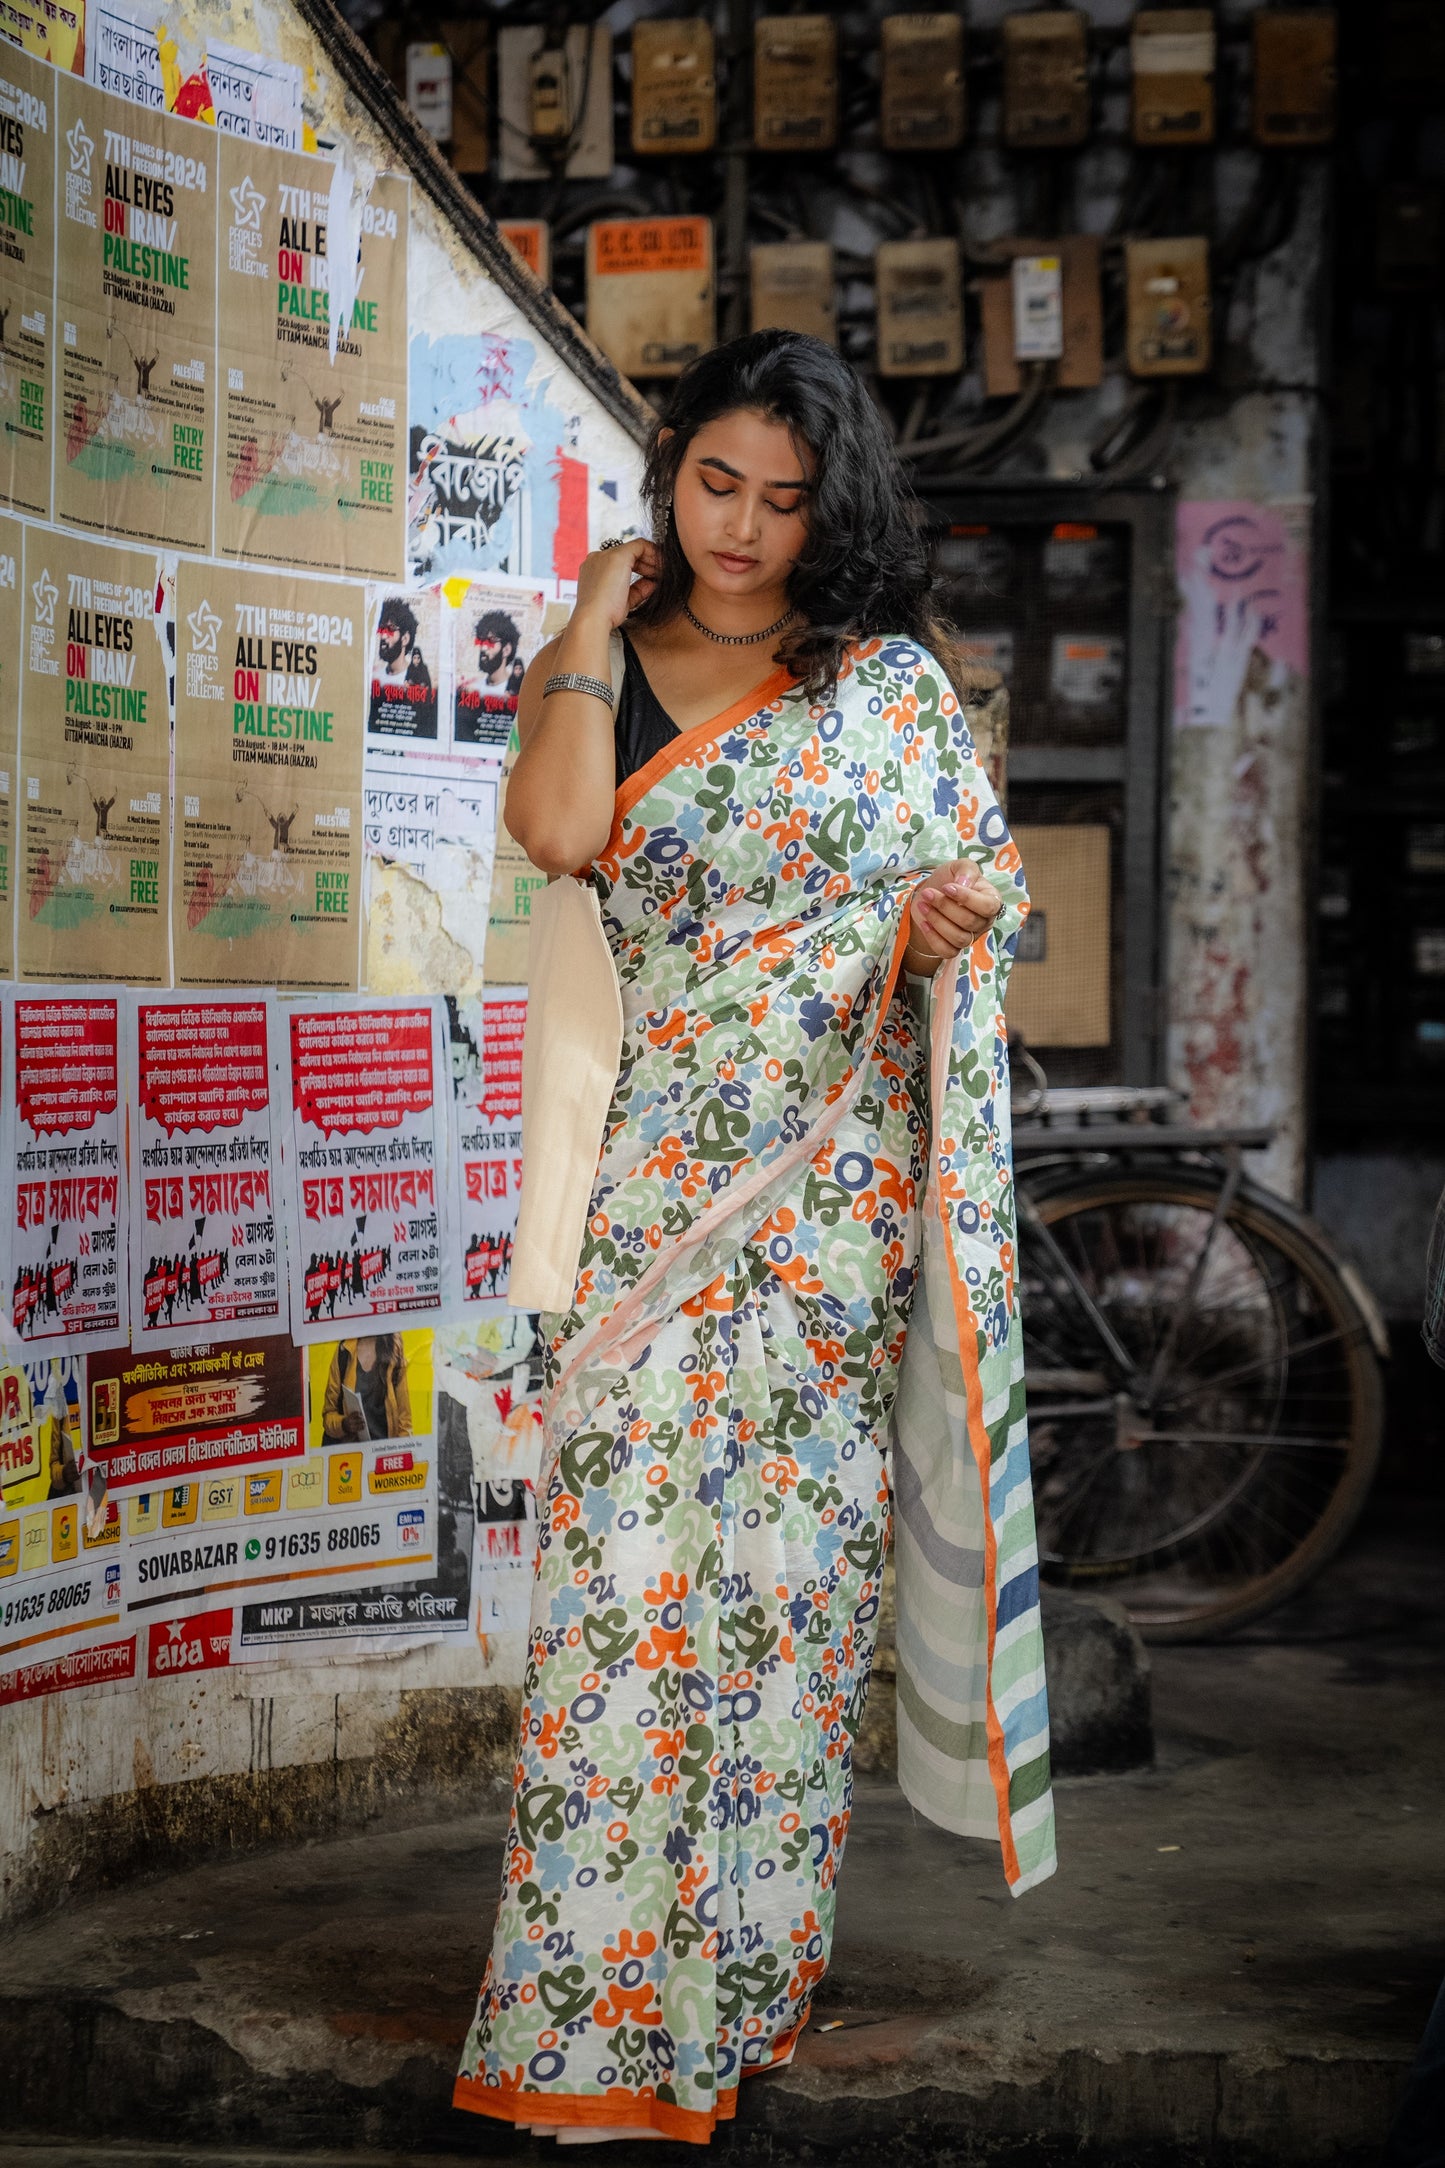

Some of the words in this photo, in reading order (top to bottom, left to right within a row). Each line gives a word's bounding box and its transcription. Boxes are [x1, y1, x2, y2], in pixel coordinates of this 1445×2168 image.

[17, 88, 47, 134] 2024
[103, 129, 131, 168] 7TH
[164, 151, 207, 192] 2024
[105, 164, 131, 203] ALL
[134, 174, 174, 217] EYES
[279, 184, 311, 220] 7TH
[104, 198, 125, 236] ON
[130, 206, 178, 252] IRAN/
[279, 217, 311, 253] ALL
[361, 204, 398, 240] 024
[103, 233, 189, 290] PALESTINE
[278, 249, 302, 284] ON
[149, 295, 175, 316] (HAZRA)
[20, 378, 44, 404] ENTRY
[20, 401, 44, 431] FREE
[173, 423, 204, 446] ENTRY
[173, 444, 203, 471] FREE
[360, 459, 394, 480] ENTRY
[360, 479, 394, 504] FREE
[67, 573, 91, 610] 7TH
[67, 608, 92, 646] ALL
[95, 614, 133, 652] EYES
[235, 603, 267, 637] 7TH
[269, 607, 296, 621] FRAMES
[269, 623, 306, 641] FREEDOM
[306, 612, 353, 647] 2024
[66, 642, 86, 679] ON
[91, 648, 136, 687] IRAN/
[186, 652, 219, 672] PEOPLE'S
[235, 636, 268, 670] ALL
[271, 640, 317, 676] EYES
[65, 679, 147, 723] PALESTINE
[186, 681, 225, 701] COLLECTIVE
[234, 669, 259, 703] ON
[266, 672, 322, 709] IRAN/
[233, 702, 334, 743] PALESTINE
[109, 735, 133, 752] (HAZRA)
[246, 739, 267, 751] August
[232, 749, 257, 764] UTTAM
[257, 751, 290, 766] MANCHA
[290, 753, 318, 769] (HAZRA)
[130, 859, 159, 879] ENTRY
[315, 872, 350, 890] ENTRY
[130, 880, 159, 904] FREE
[315, 891, 349, 913] FREE
[164, 1108, 196, 1124] কার্যকর
[197, 1108, 221, 1122] করতে
[142, 1139, 168, 1168] সংগঠিত
[170, 1146, 183, 1165] ছাত্র
[184, 1143, 228, 1169] আন্দোলনের
[229, 1135, 249, 1163] প্রতিষ্ঠা
[249, 1135, 269, 1164] দিবসে
[298, 1141, 327, 1169] সংগঠিত
[328, 1147, 342, 1167] ছাত্র
[343, 1143, 387, 1169] আন্দোলনের
[388, 1136, 411, 1163] প্রতিষ্ঠা
[411, 1136, 433, 1163] দিবসে
[144, 1176, 184, 1226] ছাত্র
[188, 1169, 271, 1216] সমাবেশ
[302, 1176, 344, 1224] ছাত্র
[349, 1168, 434, 1214] সমাবেশ
[464, 1162, 508, 1205] ছাত্র
[17, 1181, 47, 1232] ছাত্র
[49, 1175, 119, 1224] সমাবেশ
[232, 1224, 244, 1248] ১২
[245, 1215, 275, 1245] আগস্ট
[393, 1221, 407, 1243] ১২
[408, 1212, 437, 1240] আগস্ট
[235, 1252, 257, 1270] বেলা
[258, 1248, 276, 1266] ১টা
[397, 1247, 420, 1263] বেলা
[420, 1244, 439, 1261] ১টা
[234, 1274, 258, 1287] কলেজ
[208, 1290, 225, 1305] কফি
[254, 1288, 276, 1300] সামনে
[375, 1301, 397, 1313] SFI
[214, 1308, 235, 1321] SFI
[236, 1304, 276, 1317] কলকাতা
[122, 1363, 168, 1385] অর্থনীতিবিদ
[170, 1363, 188, 1377] এবং
[189, 1353, 231, 1374] সমাজকর্মী
[243, 1351, 265, 1367] দ্রেজ
[152, 1410, 186, 1426] নিরন্তর
[188, 1408, 205, 1420] এক
[206, 1402, 237, 1417] সংগ্রাম
[185, 1393, 206, 1407] জন্য
[259, 1424, 298, 1451] ইউনিয়ন
[383, 1456, 404, 1471] FREE
[250, 1482, 266, 1496] SAP
[374, 1473, 424, 1489] WORKSHOP
[208, 1487, 234, 1506] GST
[402, 1526, 419, 1542] 0%
[138, 1541, 239, 1584] SOVABAZAR
[265, 1531, 321, 1561] 91635
[327, 1523, 381, 1552] 88065
[4, 1592, 47, 1628] 91635
[47, 1580, 92, 1613] 88065
[260, 1606, 293, 1627] MKP
[309, 1603, 358, 1627] মজদুর
[362, 1594, 403, 1620] ক্রান্তি
[406, 1593, 458, 1617] পরিষদ
